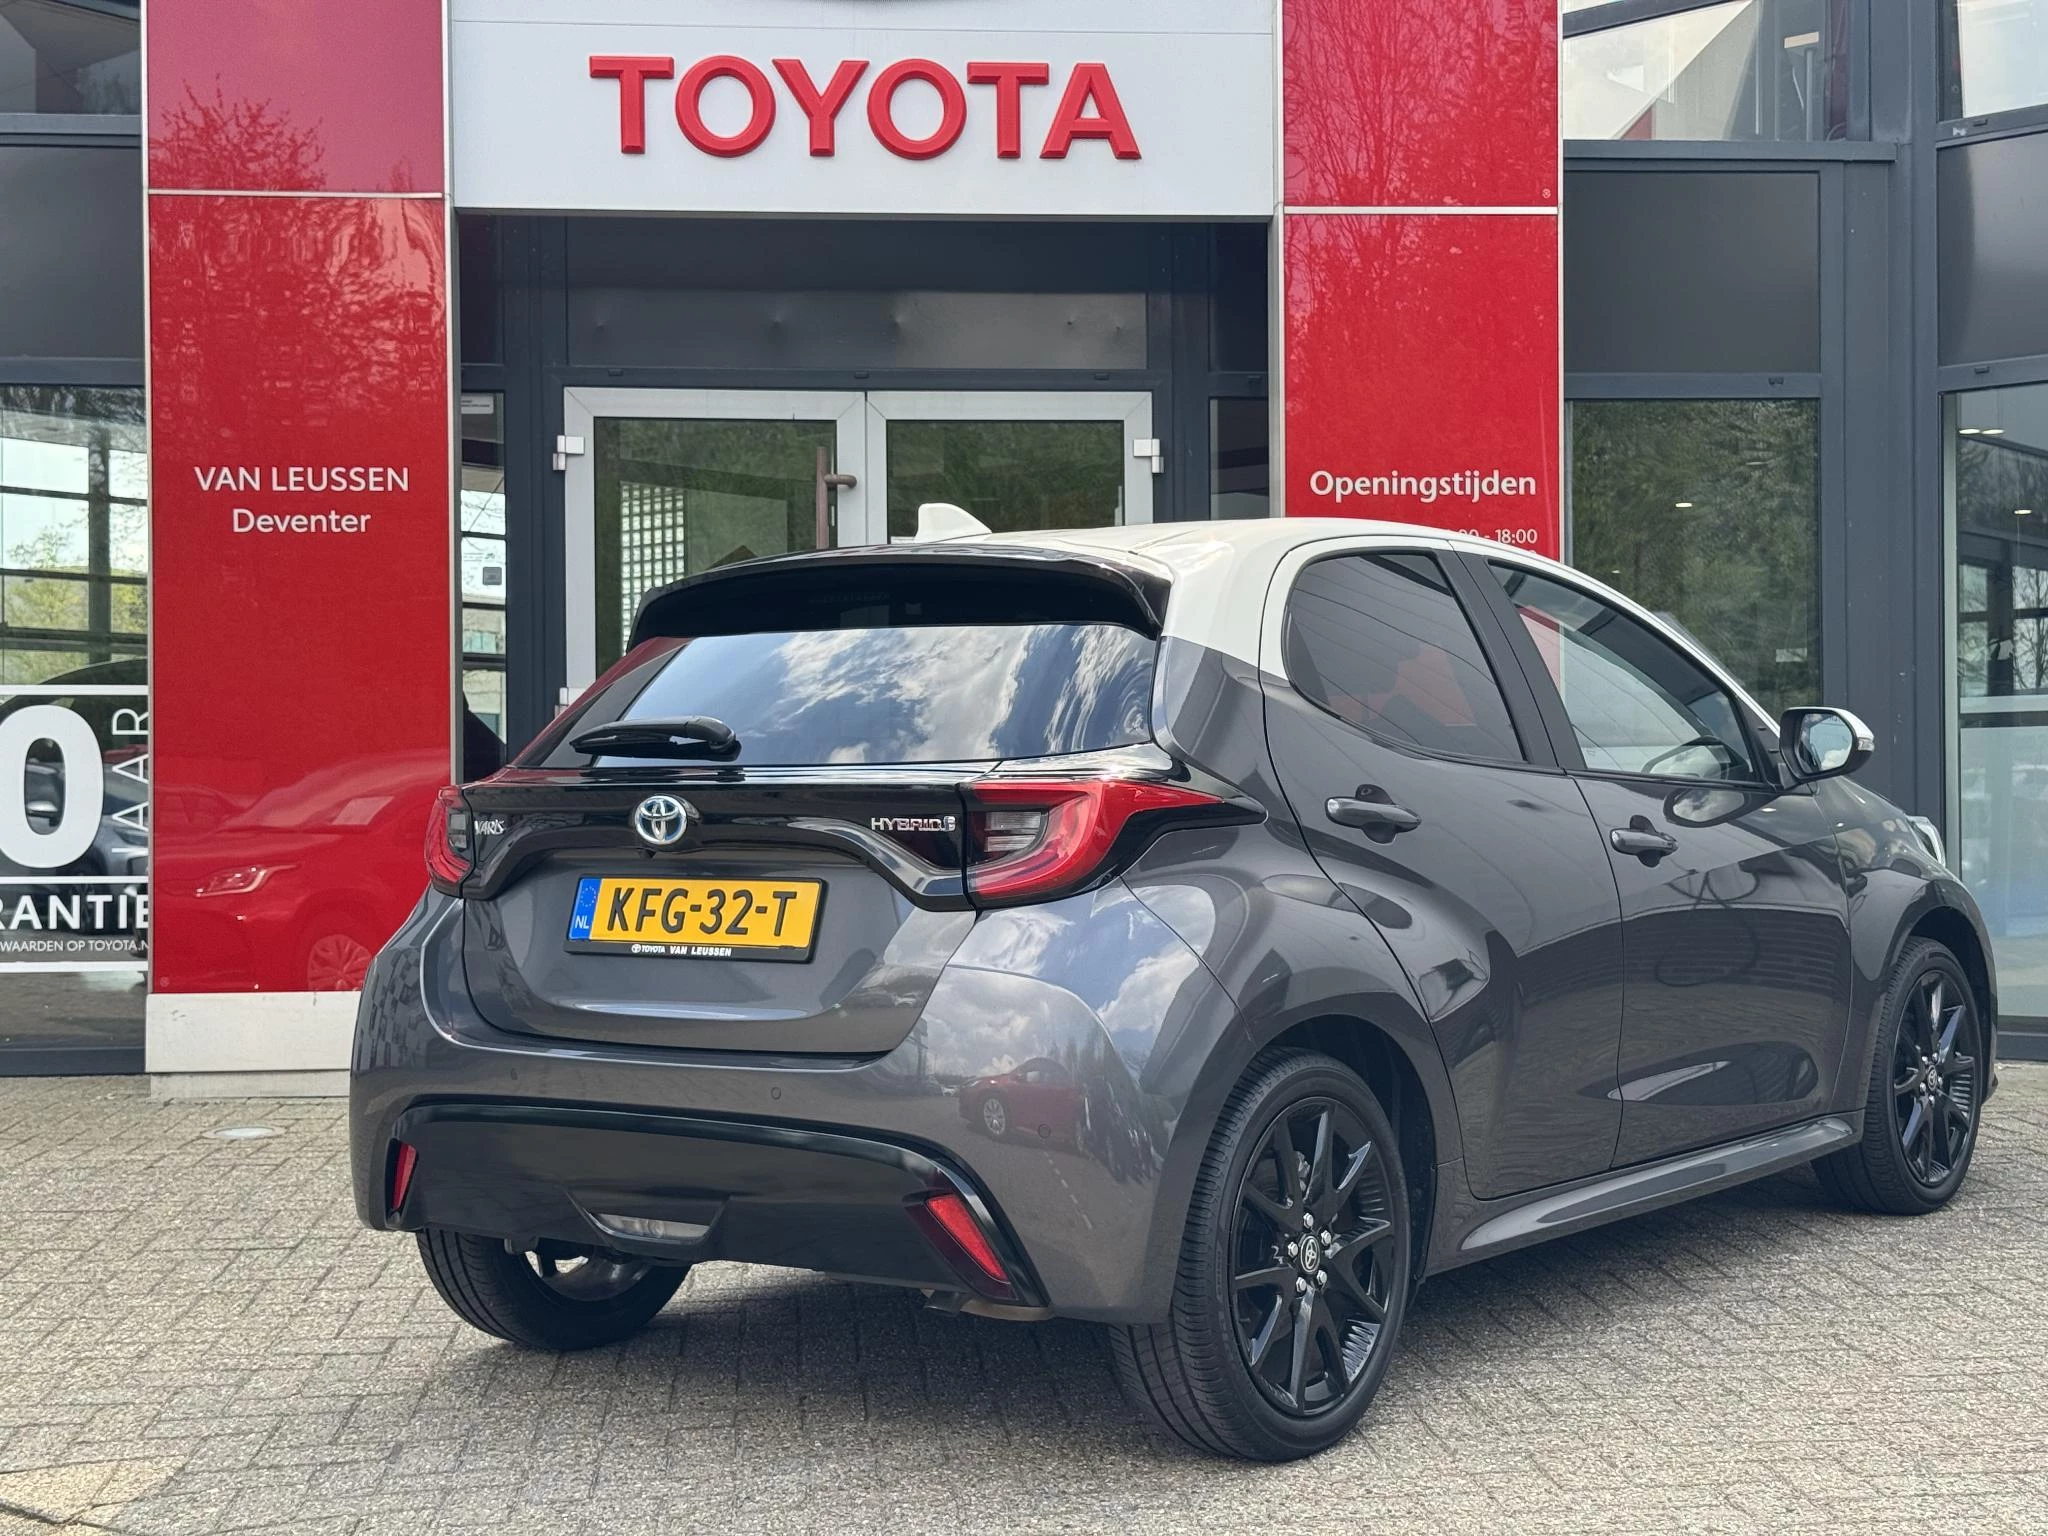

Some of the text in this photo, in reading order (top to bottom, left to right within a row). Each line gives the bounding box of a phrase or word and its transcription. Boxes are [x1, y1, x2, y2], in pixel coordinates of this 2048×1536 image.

[589, 54, 1141, 161] TOYOTA
[194, 466, 409, 492] VAN LEUSSEN
[1309, 469, 1536, 503] Openingstijden
[232, 507, 372, 533] Deventer
[1495, 528, 1538, 544] 18:00
[871, 817, 941, 831] HYBRID
[0, 894, 149, 930] ANTIE
[574, 914, 590, 930] NL
[607, 886, 797, 937] KFG-32-T
[67, 940, 86, 951] OP
[641, 945, 732, 957] TOYOTA VAN LEUSSEN
